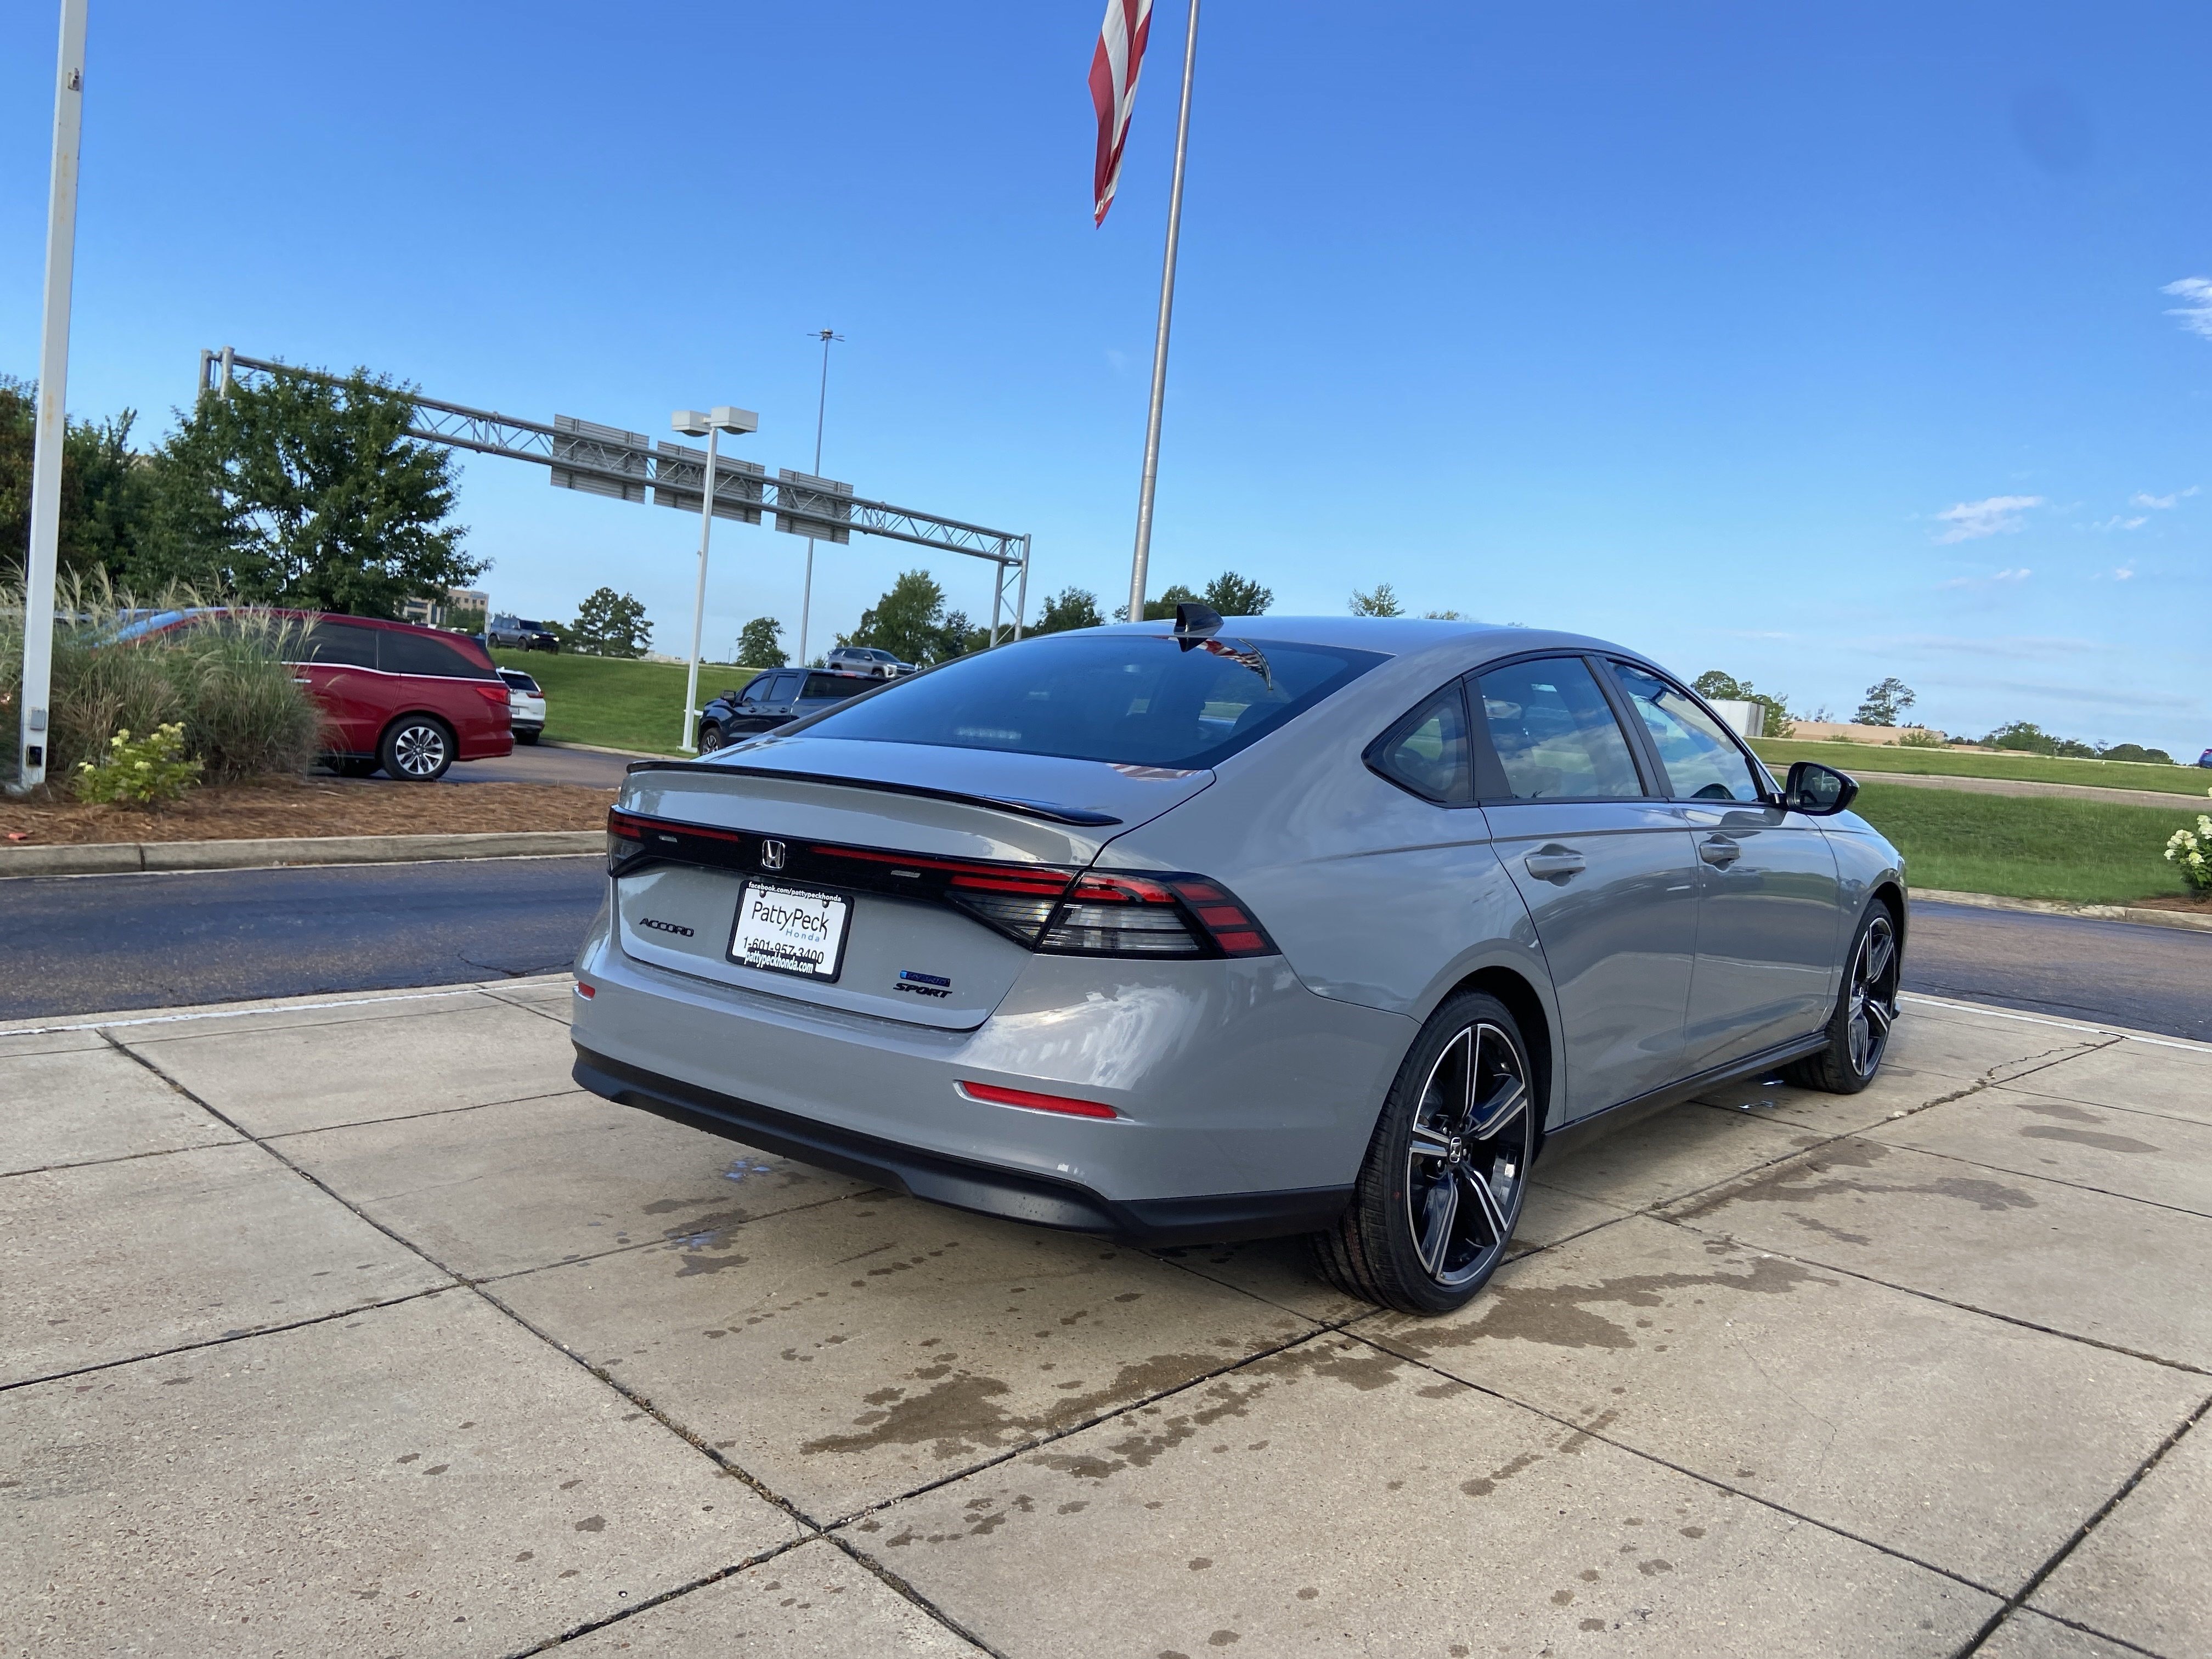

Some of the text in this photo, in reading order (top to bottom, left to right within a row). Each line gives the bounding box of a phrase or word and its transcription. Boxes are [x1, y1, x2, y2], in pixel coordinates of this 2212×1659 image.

[749, 882, 842, 902] facebook.com/pattypeckhonda
[639, 918, 695, 937] ACCORD
[752, 901, 830, 940] PattyPeck
[786, 928, 820, 942] Honda
[743, 950, 814, 974] pattypeckhonda.com
[893, 983, 953, 998] SPORT
